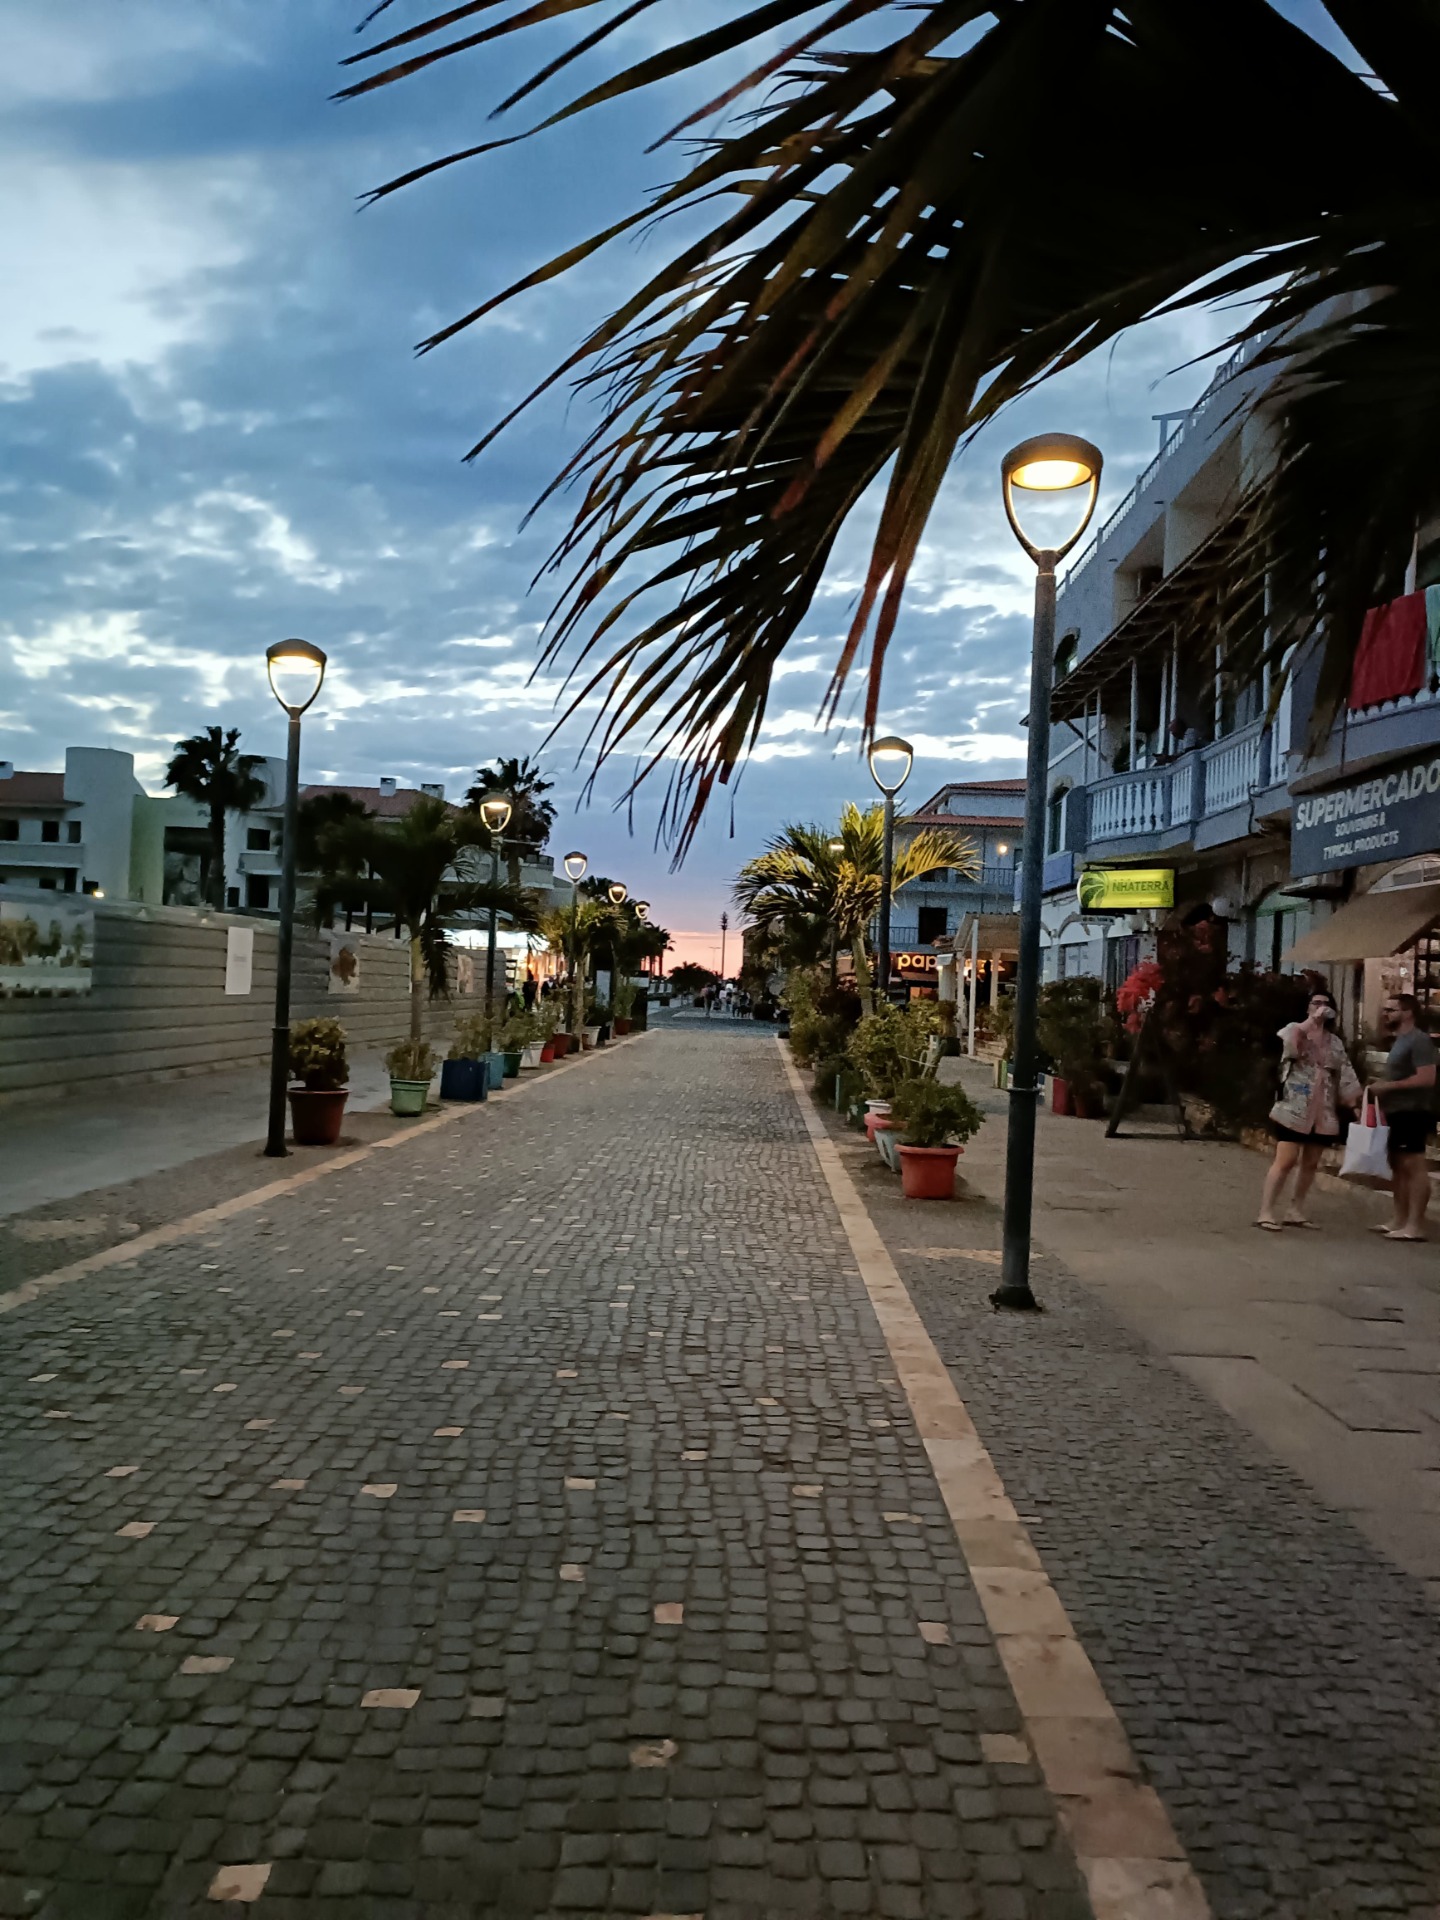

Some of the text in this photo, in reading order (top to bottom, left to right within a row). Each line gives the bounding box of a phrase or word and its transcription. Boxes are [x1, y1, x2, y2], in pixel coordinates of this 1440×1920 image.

[1296, 758, 1440, 830] SUPERMERCADO
[1323, 831, 1399, 860] TYPICAL PRODUCTS
